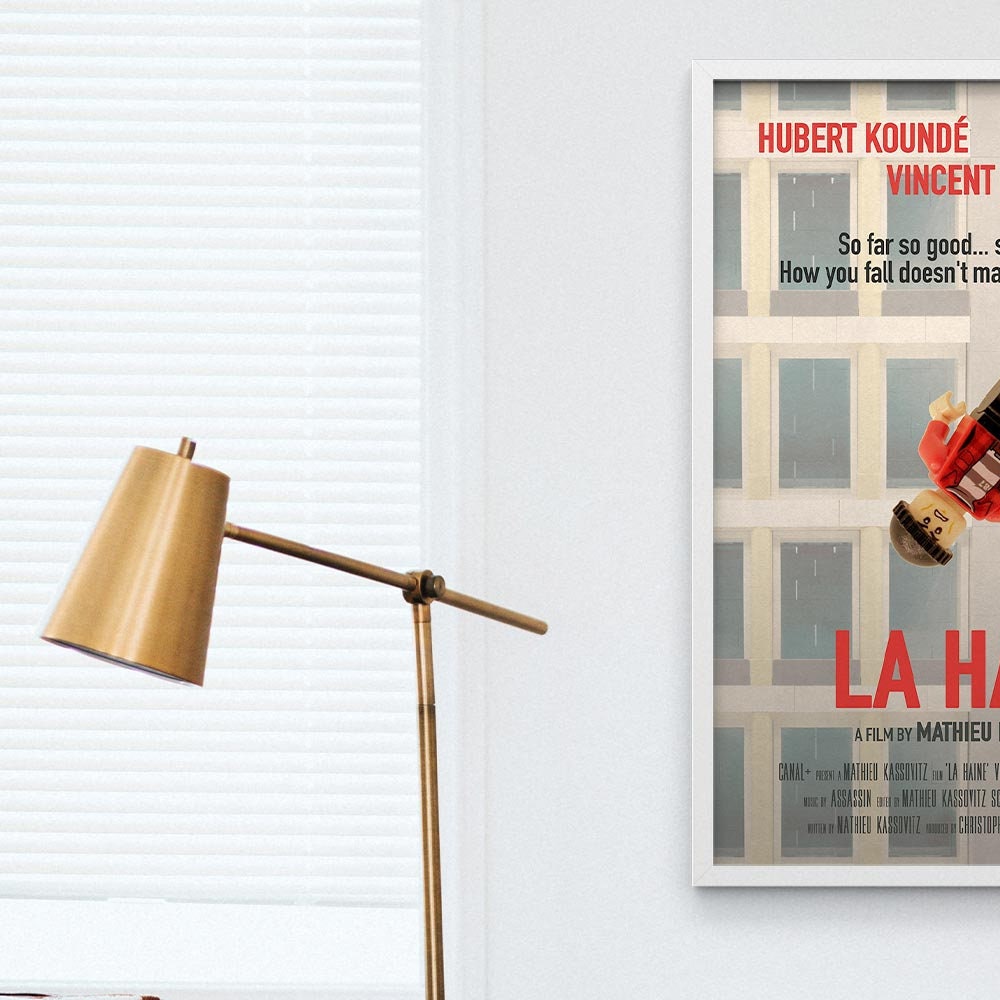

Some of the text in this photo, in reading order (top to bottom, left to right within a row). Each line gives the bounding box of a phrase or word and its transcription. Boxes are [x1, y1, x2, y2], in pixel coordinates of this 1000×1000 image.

[758, 115, 969, 154] HUBERT KOUNDÉ
[886, 164, 996, 196] VINCENT
[838, 232, 861, 256] So
[867, 232, 894, 256] far
[899, 238, 921, 256] so
[926, 232, 989, 260] good...
[779, 260, 819, 284] How
[825, 267, 858, 289] you
[863, 260, 894, 284] fall
[899, 260, 968, 284] doesn't
[835, 630, 921, 709] LA
[854, 727, 863, 743] A
[865, 727, 893, 743] FILM
[896, 727, 913, 743] BY
[916, 721, 993, 743] MATHIEU
[778, 762, 811, 781] CANAL+
[837, 770, 842, 781] A
[843, 762, 878, 781] MATHIEU
[883, 762, 928, 781] KASSOVITZ
[830, 789, 872, 808] ASSASSIN
[902, 789, 937, 808] MATHIEU
[942, 789, 986, 808] KASSOVITZ
[876, 815, 921, 834] KASSOVITZ
